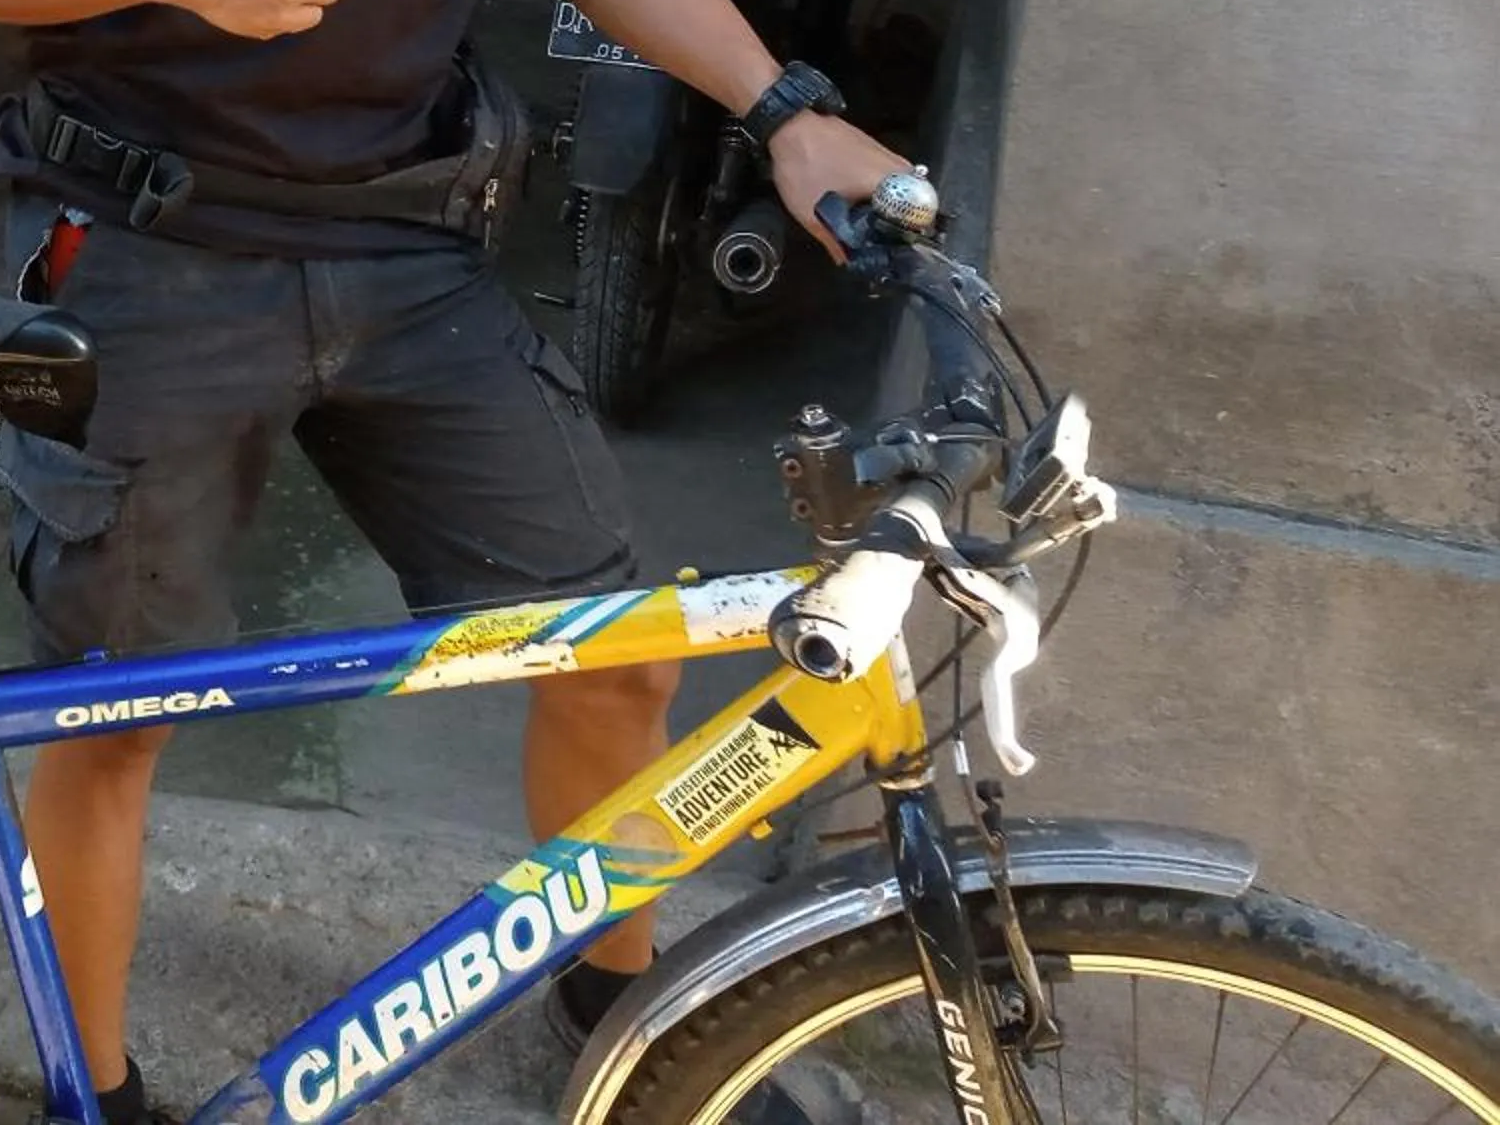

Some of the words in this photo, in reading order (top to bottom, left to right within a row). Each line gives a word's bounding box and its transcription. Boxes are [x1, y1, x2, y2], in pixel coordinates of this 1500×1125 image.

[55, 687, 236, 728] OMEGA
[675, 743, 769, 829] ADVENTURE
[704, 792, 746, 830] NOTHING
[284, 848, 607, 1122] CARIBOU
